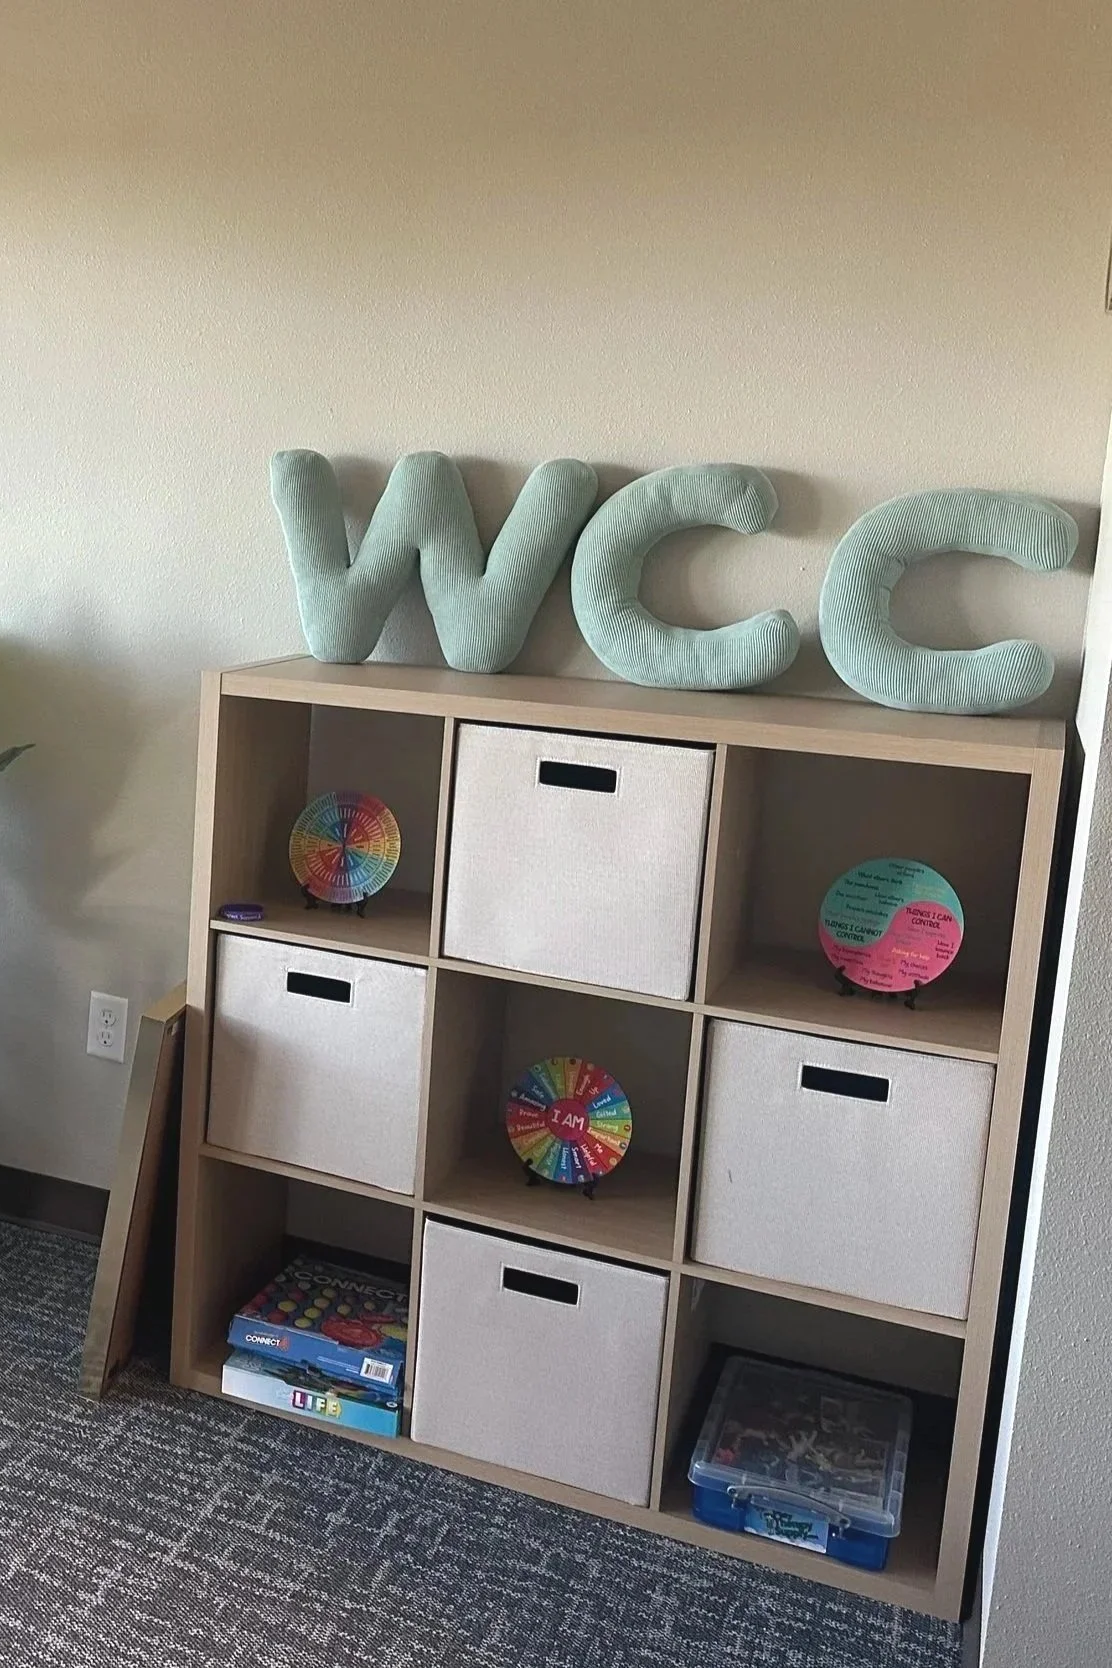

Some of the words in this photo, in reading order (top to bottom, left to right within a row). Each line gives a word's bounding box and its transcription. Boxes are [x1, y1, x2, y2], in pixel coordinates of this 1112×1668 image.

[270, 448, 1079, 712] WCC
[906, 907, 931, 920] THINGS
[936, 911, 953, 922] CAN
[824, 920, 848, 932] THINGS
[854, 925, 883, 938] CANNOT
[911, 918, 941, 929] CONTROL
[835, 931, 865, 942] CONTROL
[900, 960, 910, 969] My
[519, 1093, 546, 1111] Amazing
[592, 1094, 612, 1109] Loved
[551, 1109, 561, 1123] I
[562, 1113, 585, 1131] AM
[594, 1143, 604, 1154] Me
[571, 1146, 582, 1169] Smart
[293, 1271, 408, 1302] CONNECT
[245, 1334, 280, 1346] CONNECT
[292, 1390, 341, 1418] LIFE
